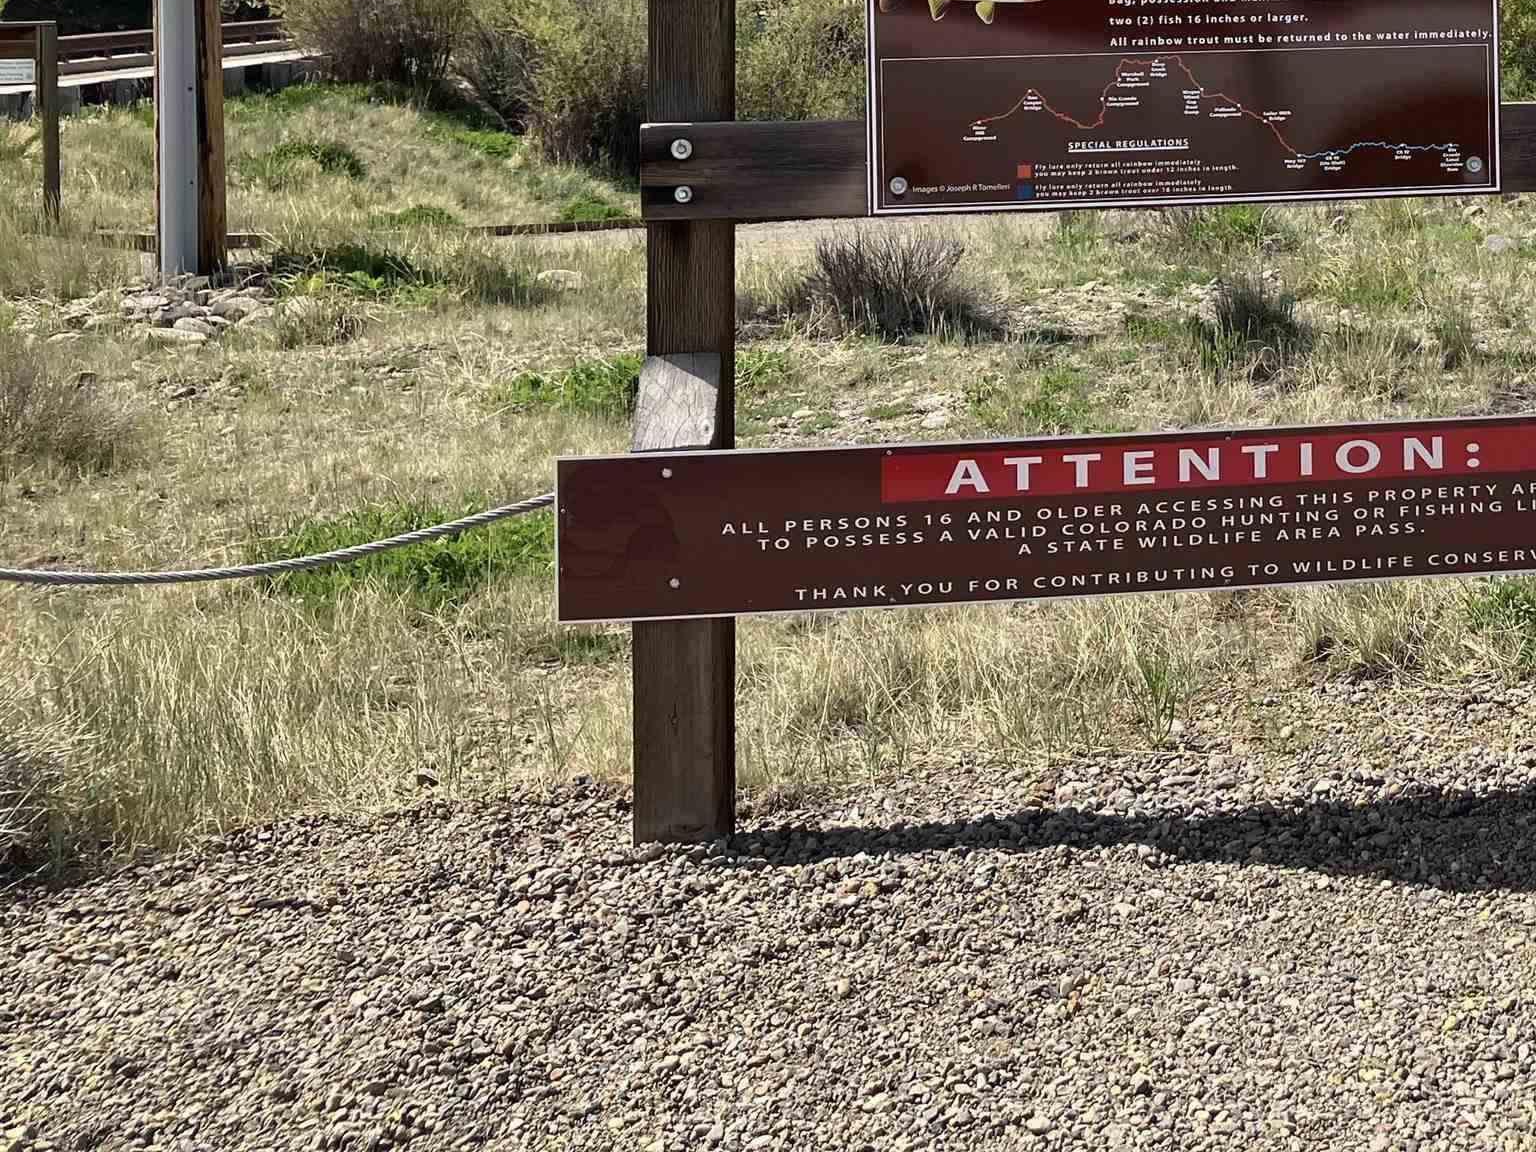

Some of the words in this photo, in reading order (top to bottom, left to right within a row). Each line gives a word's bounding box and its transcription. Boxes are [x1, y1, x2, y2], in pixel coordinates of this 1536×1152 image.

[1068, 141, 1111, 149] SPECIAL
[1116, 138, 1189, 148] REGULATIONS
[944, 436, 1480, 494] ATTENTION:
[722, 521, 769, 535] ALL
[785, 515, 907, 532] PERSONS
[924, 513, 952, 526] 16
[967, 510, 1022, 524] AND
[1037, 504, 1122, 520] OLDER
[1137, 495, 1283, 515] ACCESSING
[1296, 491, 1353, 505] THIS
[1368, 484, 1497, 502] PROPERTY
[757, 538, 790, 551] TO
[806, 531, 924, 548] POSSESS
[939, 530, 953, 542] A
[967, 525, 1047, 540] VALID
[1062, 516, 1206, 536] COLORADO
[1221, 509, 1339, 527] HUNTING
[1353, 507, 1385, 520] OR
[1399, 500, 1502, 517] FISHING
[1018, 543, 1032, 555] A
[1047, 538, 1124, 554] STATE
[1138, 530, 1261, 549] WILDLIFE
[1276, 526, 1341, 541] AREA
[1356, 522, 1425, 537] PASS.
[794, 584, 886, 601] THANK
[900, 581, 953, 596] YOU
[969, 578, 1018, 592] FOR
[1033, 566, 1234, 589] CONTRIBUTING
[1247, 563, 1279, 576] TO
[1292, 555, 1413, 574] WILDLIFE
